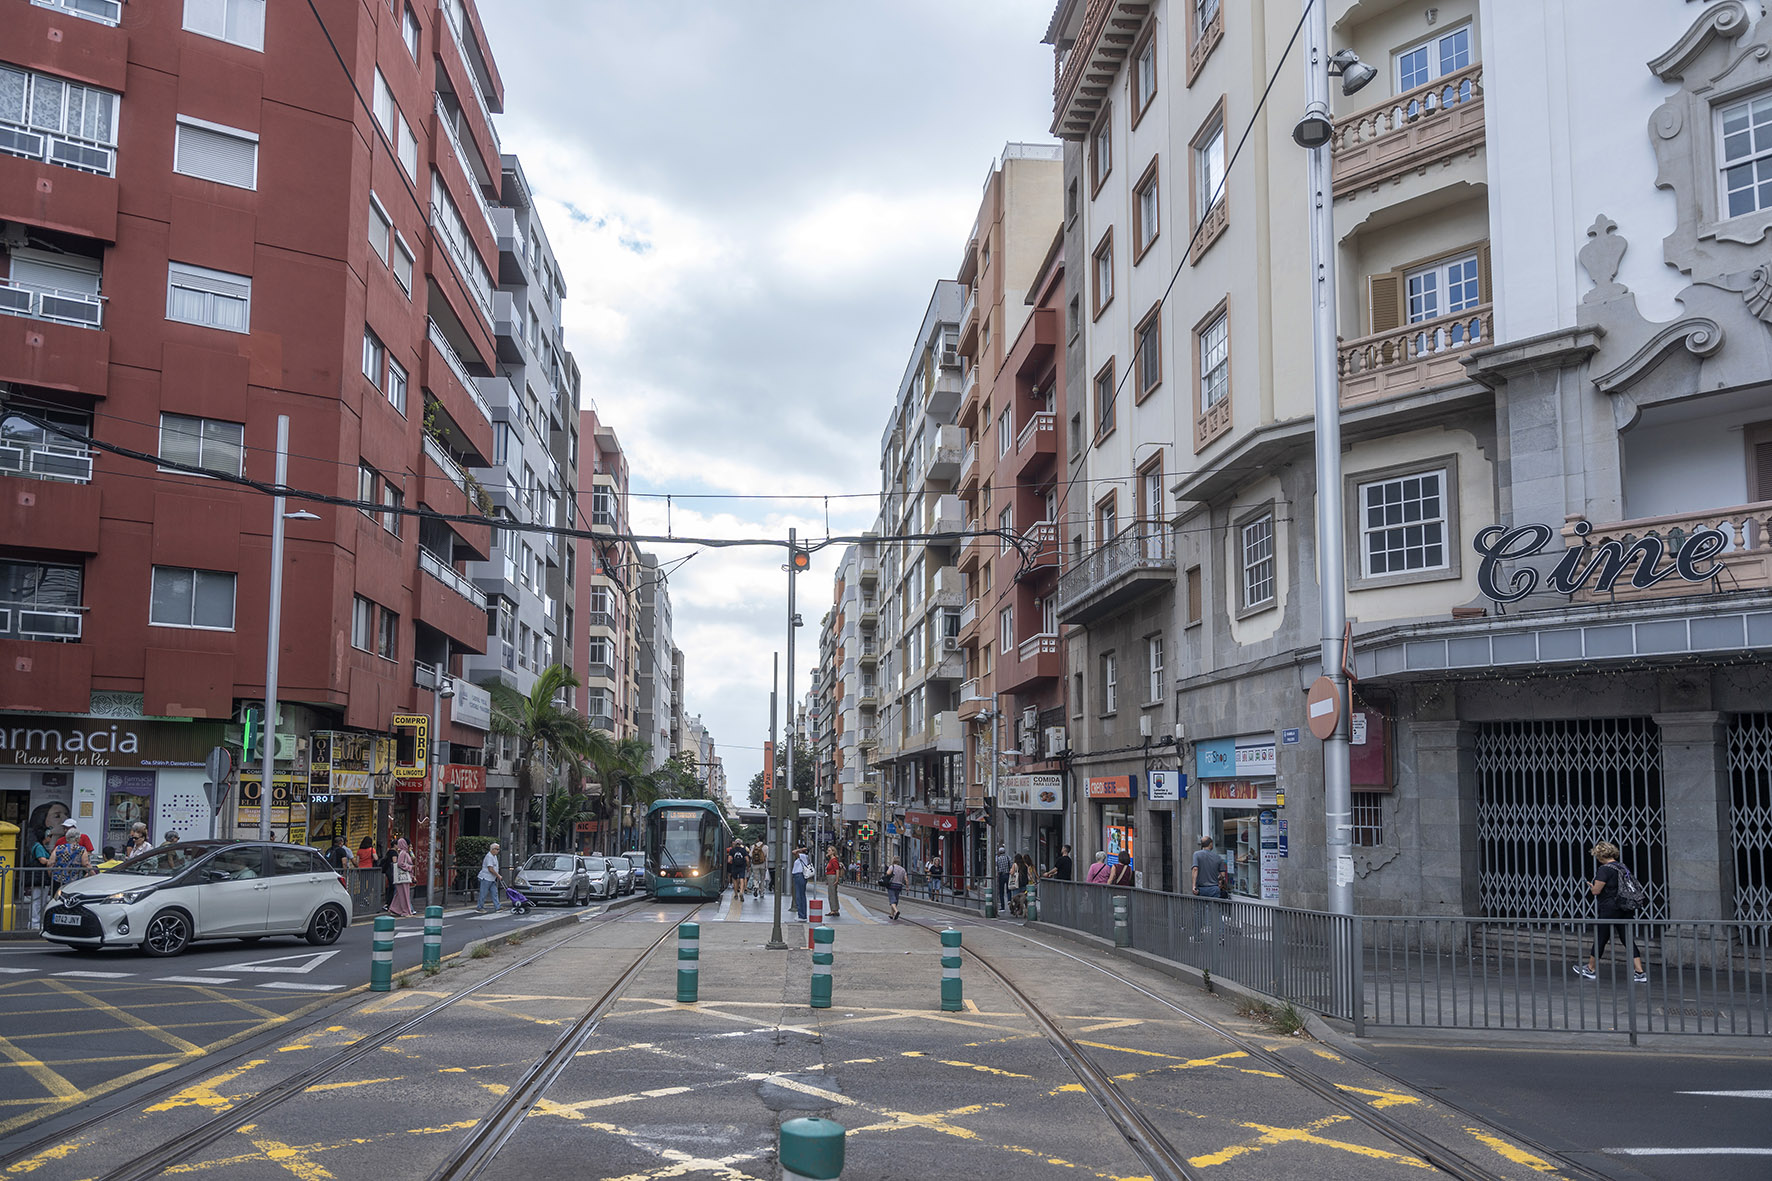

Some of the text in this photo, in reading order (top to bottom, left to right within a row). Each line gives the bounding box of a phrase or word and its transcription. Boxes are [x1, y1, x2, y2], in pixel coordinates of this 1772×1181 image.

[1472, 520, 1728, 602] Cine
[417, 726, 425, 759] ORO
[15, 750, 50, 765] Plaza
[54, 751, 69, 765] de
[90, 752, 110, 766] Paz
[450, 768, 479, 790] ANFER'S
